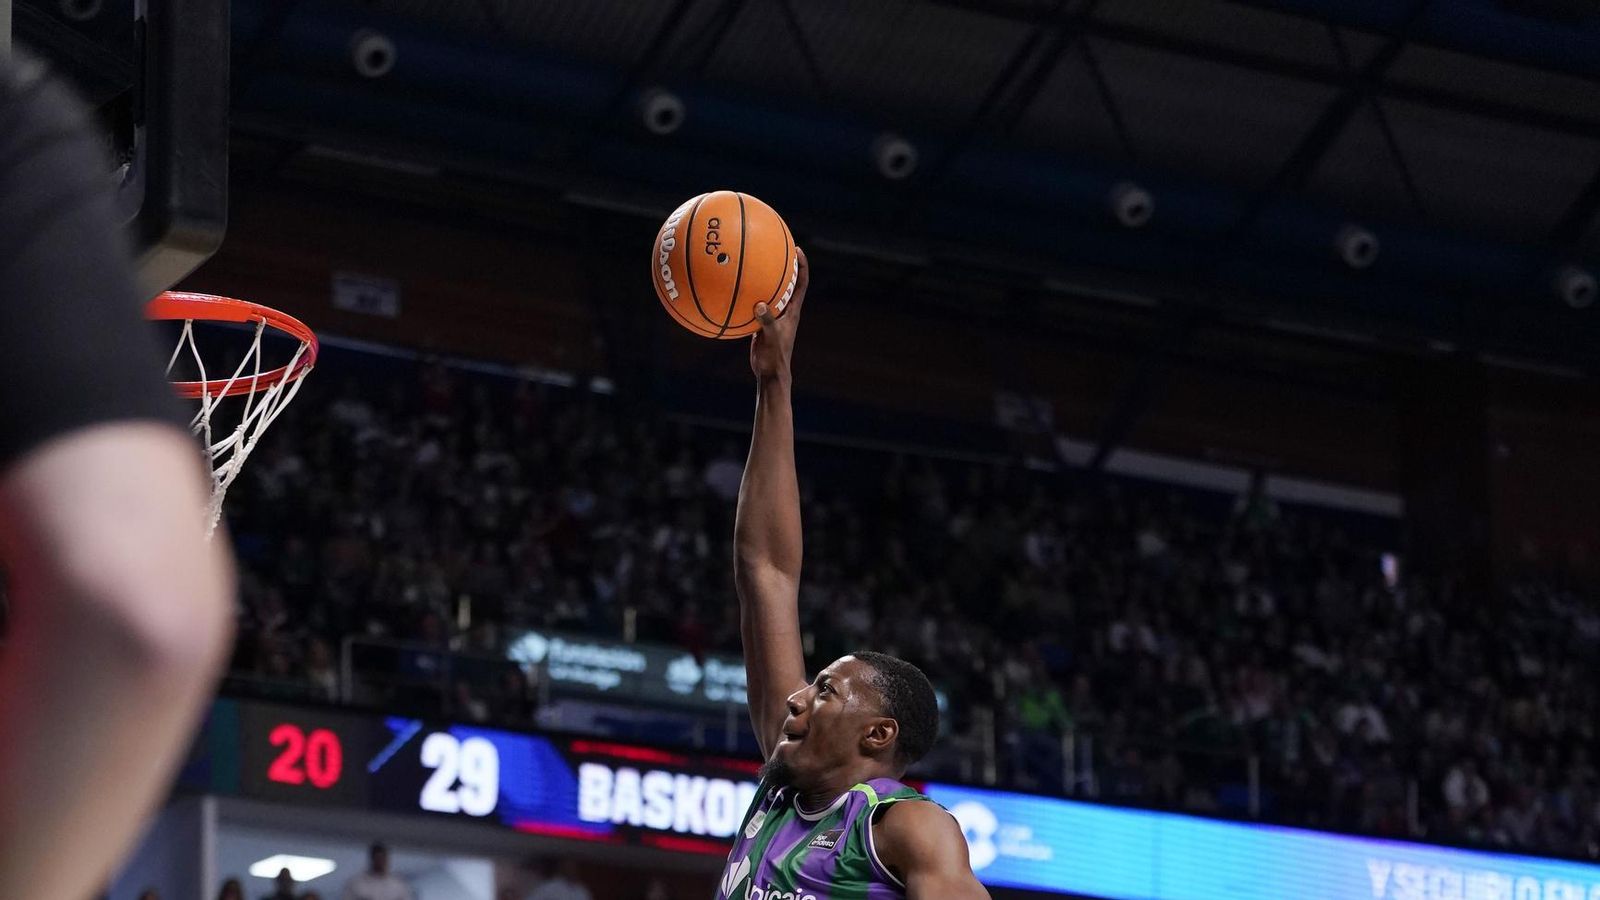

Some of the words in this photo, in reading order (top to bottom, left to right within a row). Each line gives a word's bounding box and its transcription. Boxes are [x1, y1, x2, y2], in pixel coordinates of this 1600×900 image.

[705, 217, 721, 255] acb
[267, 723, 343, 789] 20
[418, 731, 500, 817] 29
